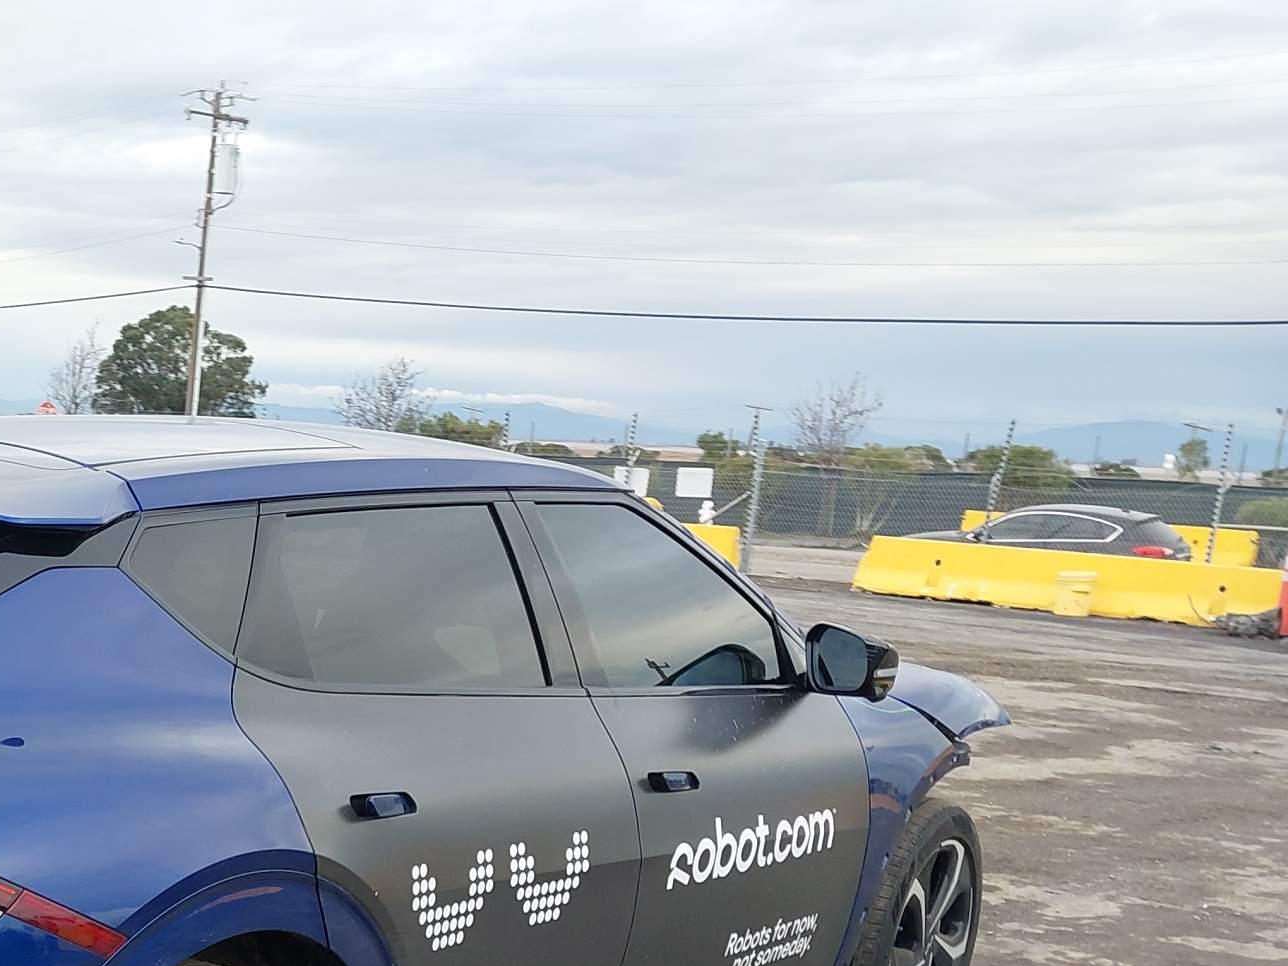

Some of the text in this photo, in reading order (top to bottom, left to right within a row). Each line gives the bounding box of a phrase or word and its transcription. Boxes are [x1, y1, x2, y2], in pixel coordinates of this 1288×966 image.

[724, 912, 819, 957] Robots for now,
